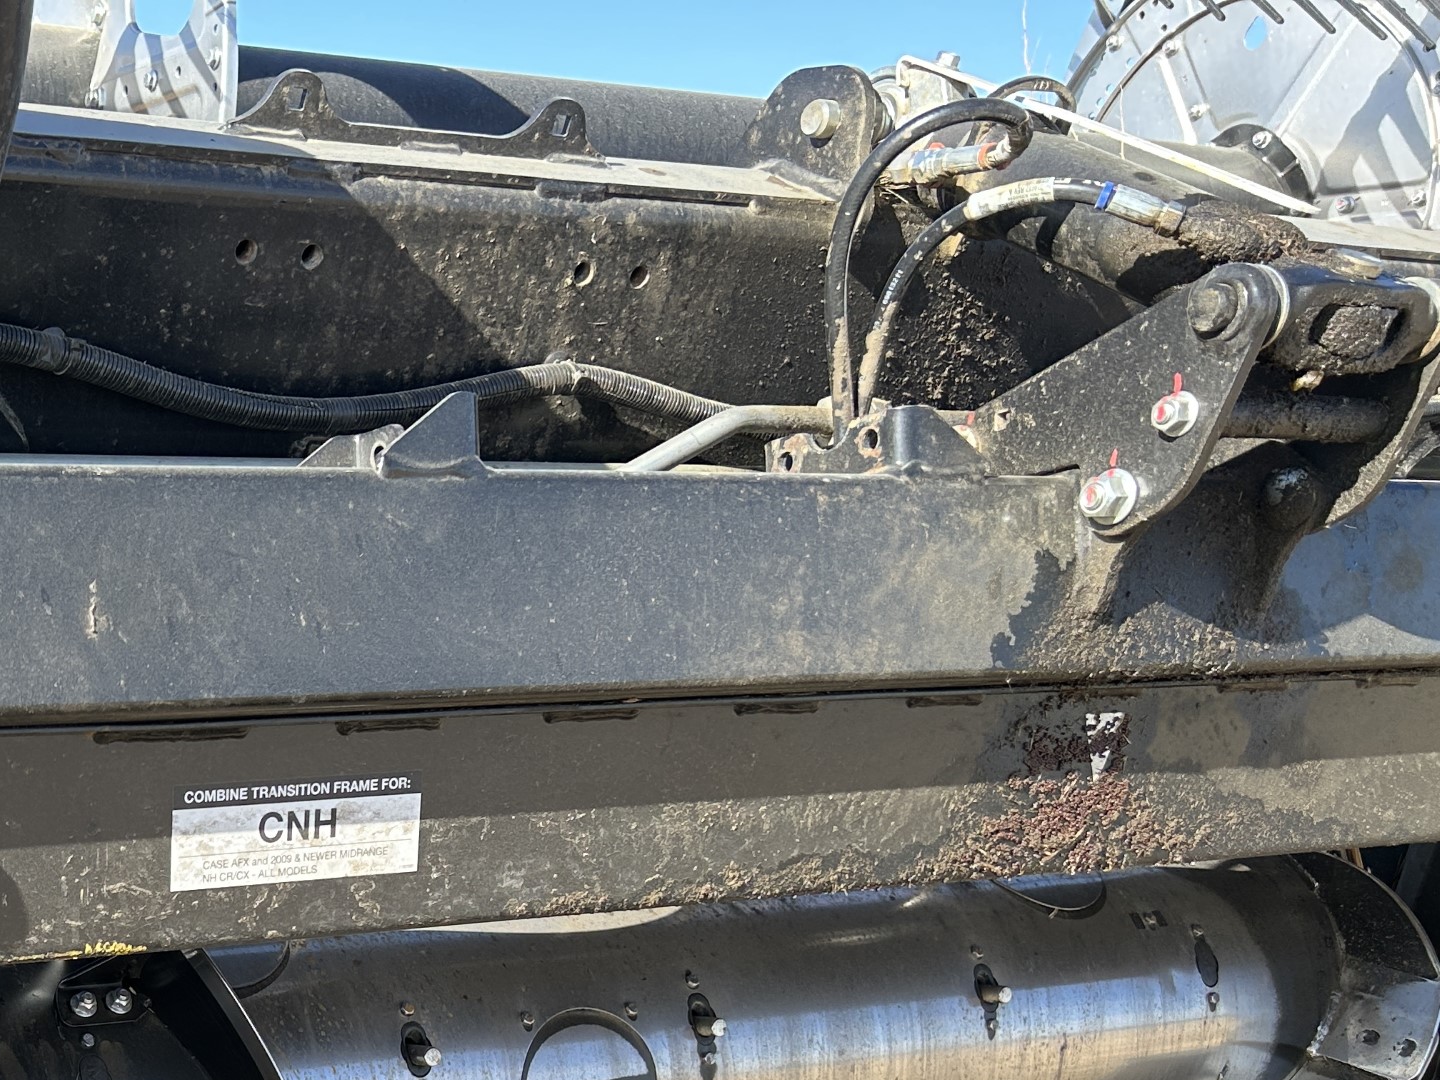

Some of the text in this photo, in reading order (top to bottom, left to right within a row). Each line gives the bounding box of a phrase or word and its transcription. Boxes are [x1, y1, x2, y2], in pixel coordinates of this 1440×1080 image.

[184, 776, 411, 804] COMBINE TRANSITION FRAME FOR:
[258, 808, 337, 844] CNH
[203, 846, 389, 870] CASE AFX and 2009 & NEWER MIDRANGE
[202, 873, 218, 883] NH
[219, 870, 250, 882] CR/CX
[258, 868, 277, 879] ALL
[278, 865, 318, 877] MODELS
